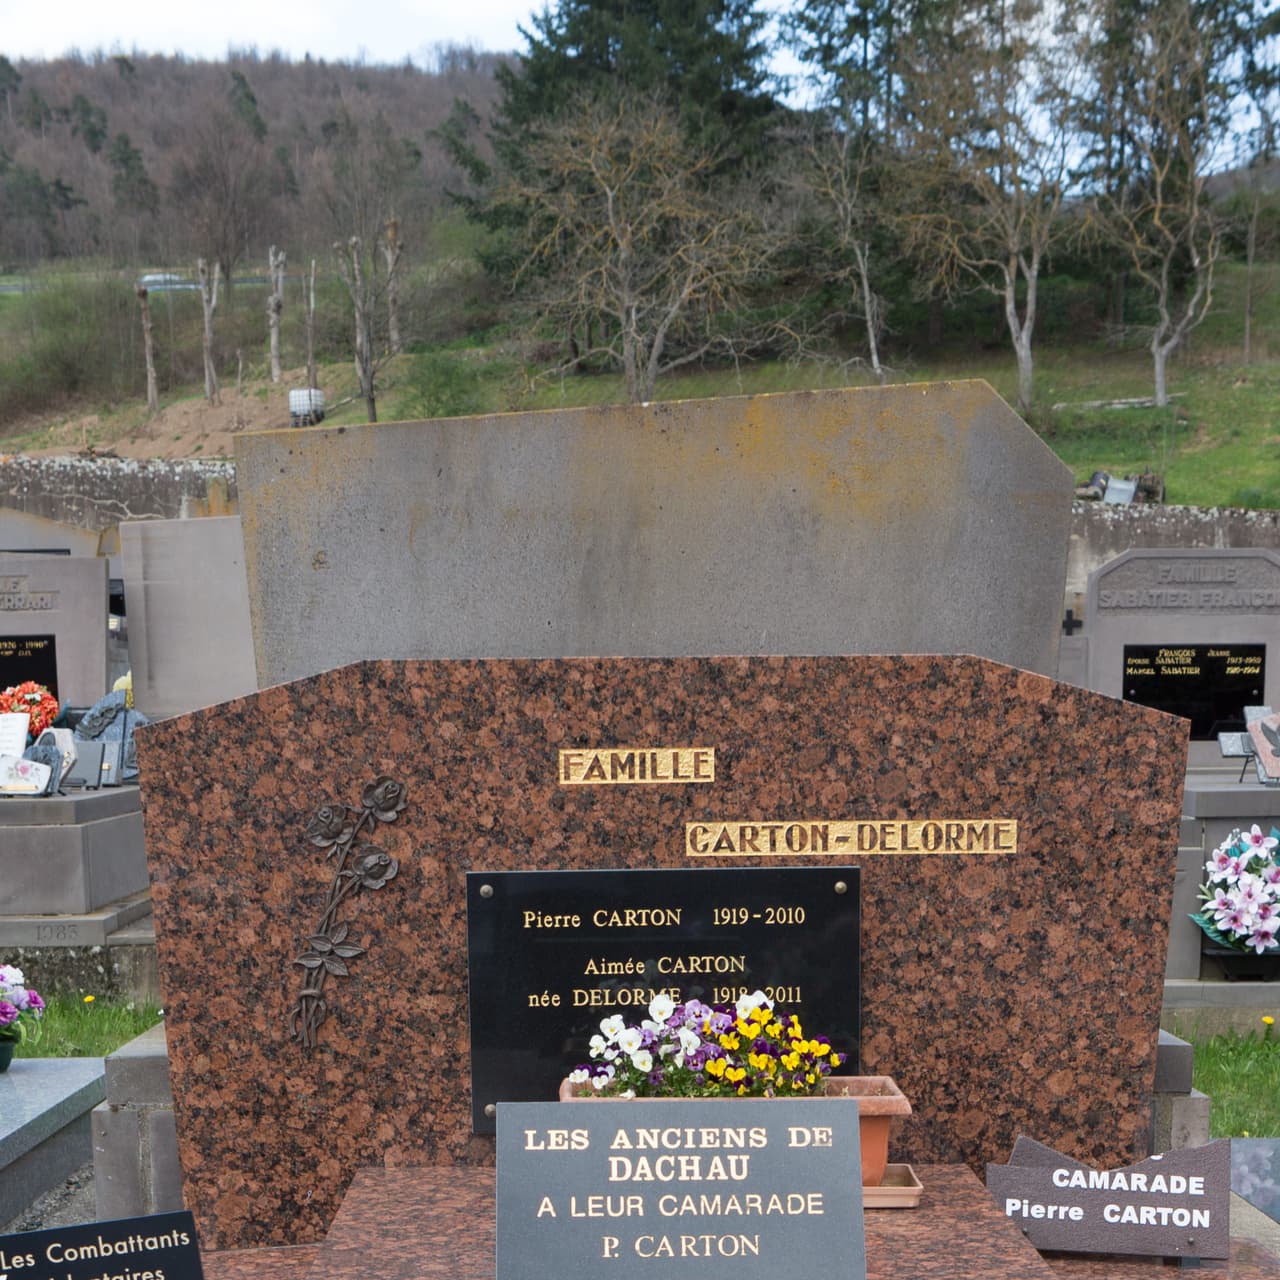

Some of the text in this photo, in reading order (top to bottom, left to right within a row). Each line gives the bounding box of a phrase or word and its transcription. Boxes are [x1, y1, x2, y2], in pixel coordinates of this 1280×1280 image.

[1099, 590, 1194, 609] SABATIER
[562, 750, 712, 782] FAMILLE
[688, 821, 1016, 854] CARTON-DELORME
[523, 909, 581, 929] Pierre
[593, 908, 682, 927] CARTON
[584, 955, 746, 975] Aimée CARTON
[528, 990, 561, 1007] née
[525, 1126, 833, 1151] LES ANCIENS DE
[608, 1155, 750, 1181] DACHAU
[1052, 1169, 1205, 1195] CAMARADE
[537, 1193, 824, 1218] A LEUR CAMARADE
[1005, 1198, 1210, 1228] Pierre CARTON
[0, 1229, 190, 1270] Les Combattants
[602, 1234, 760, 1258] P. CARTON
